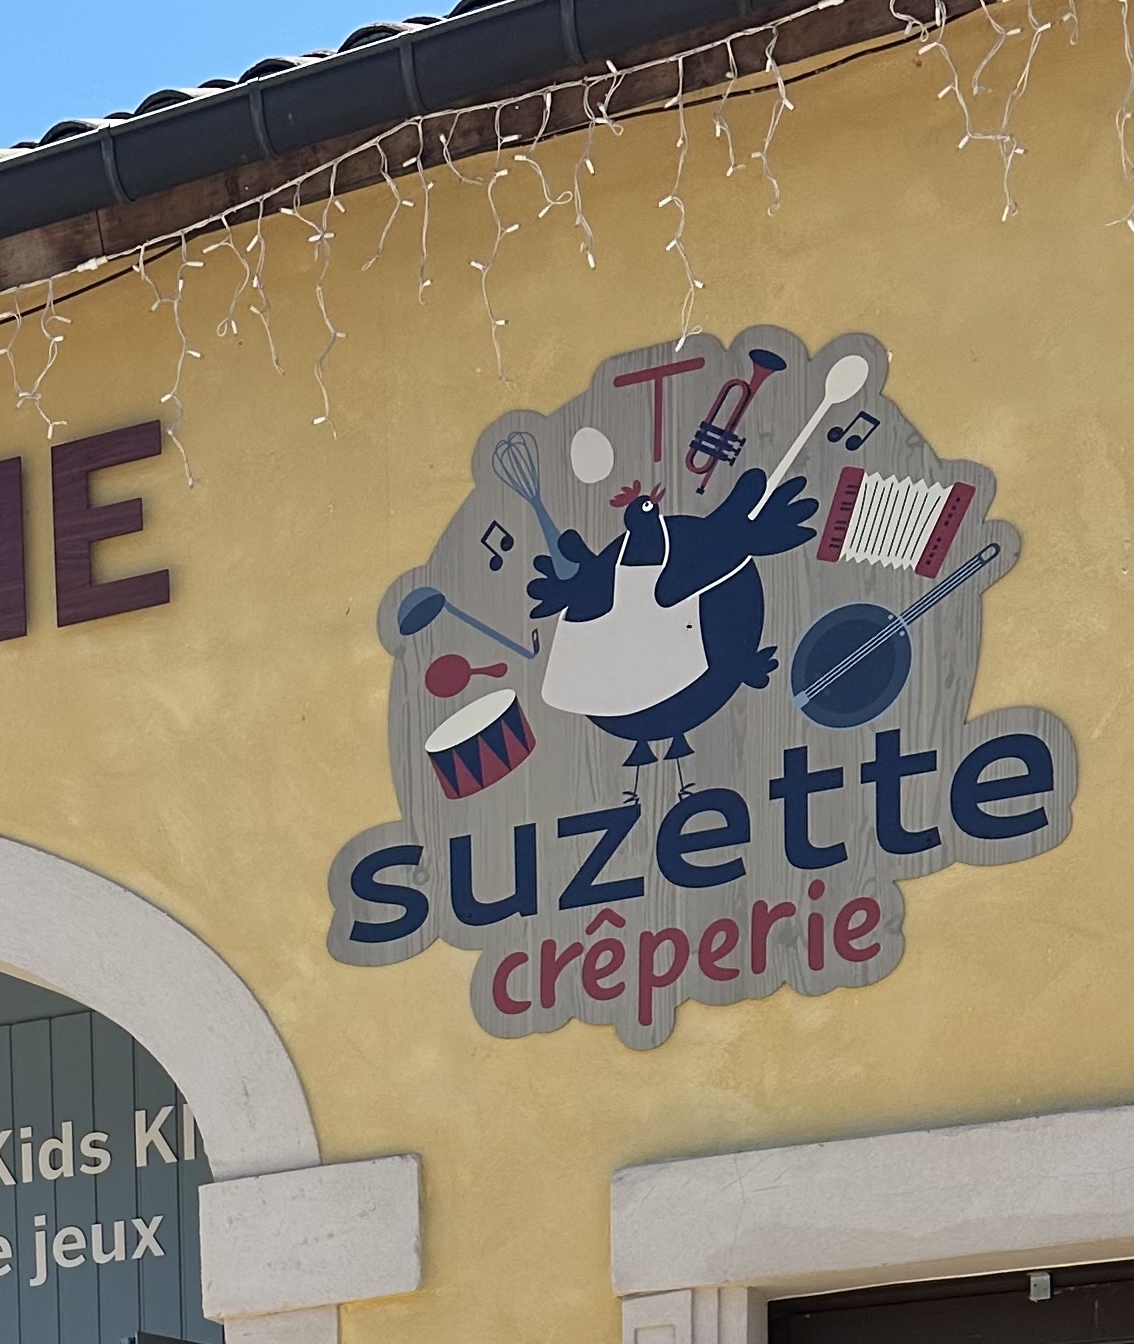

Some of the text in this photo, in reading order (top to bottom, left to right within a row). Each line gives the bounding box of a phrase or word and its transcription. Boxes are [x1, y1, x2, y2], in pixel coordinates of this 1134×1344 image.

[349, 728, 1055, 944] suzette
[492, 879, 883, 1027] crêperie
[30, 1214, 166, 1287] jeux
